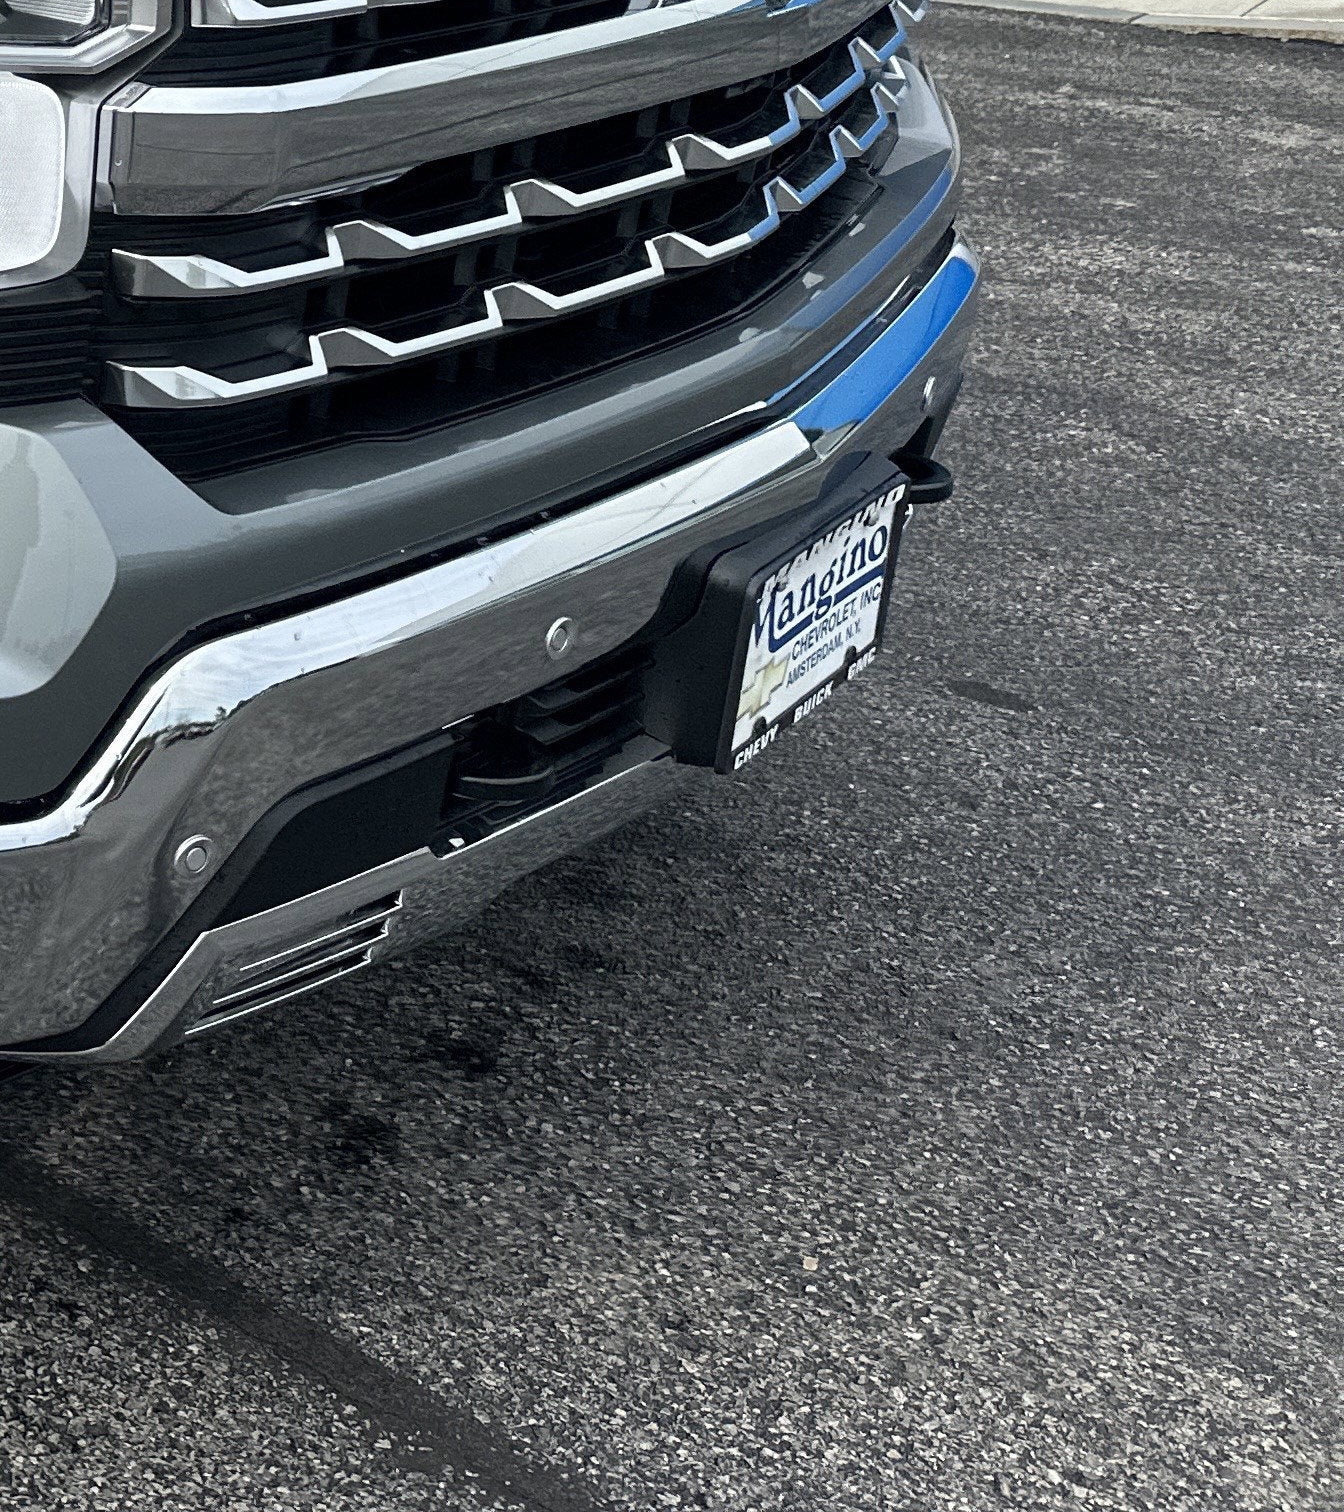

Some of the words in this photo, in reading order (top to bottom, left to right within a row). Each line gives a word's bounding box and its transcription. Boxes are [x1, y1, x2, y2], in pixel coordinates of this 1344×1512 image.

[753, 525, 888, 653] Mangino
[733, 723, 779, 770] CHEVY
[793, 679, 835, 724] BUICK
